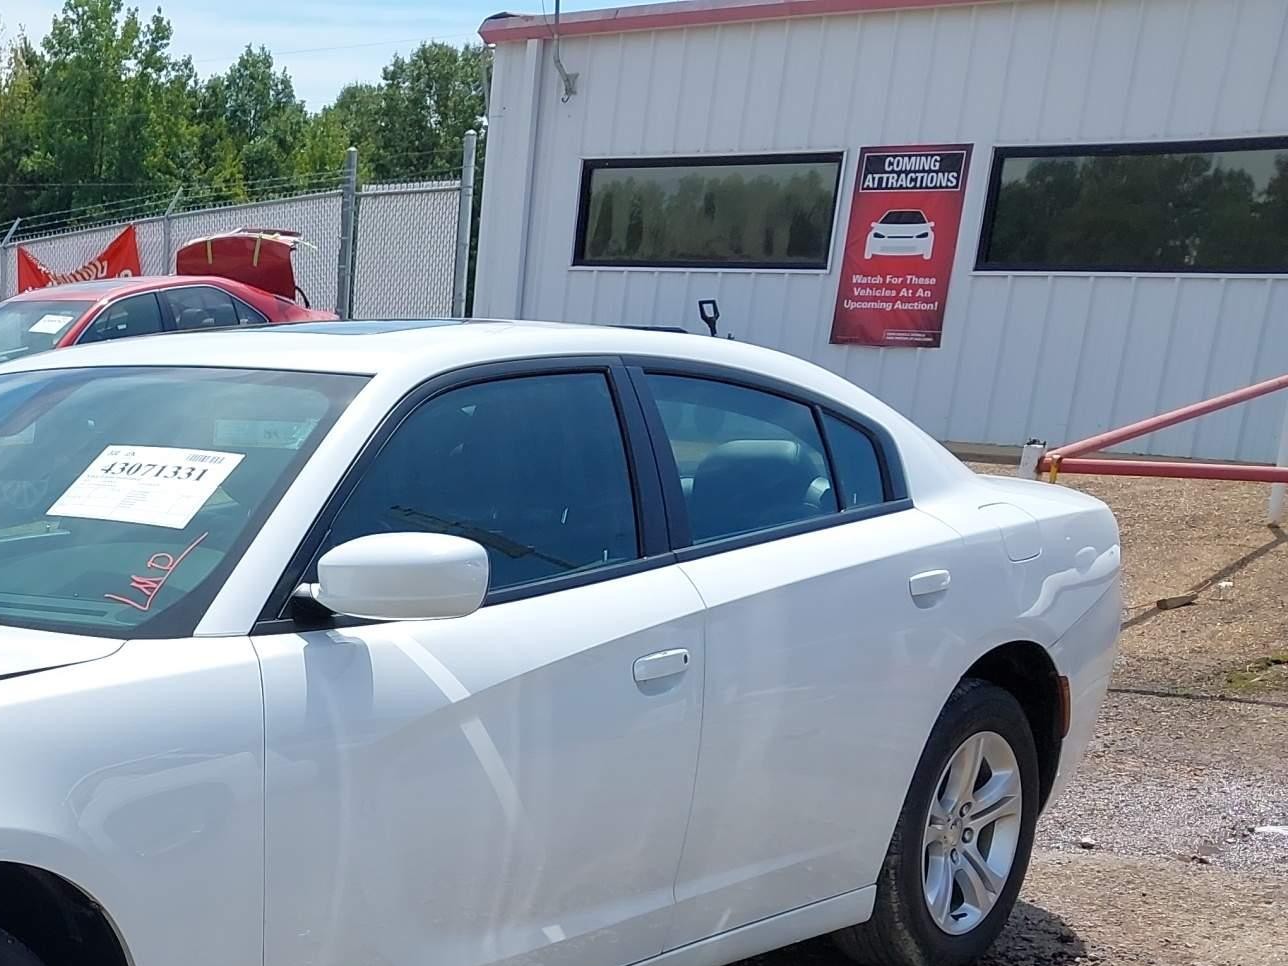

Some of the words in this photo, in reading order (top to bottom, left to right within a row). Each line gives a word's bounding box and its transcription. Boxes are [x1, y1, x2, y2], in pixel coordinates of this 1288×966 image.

[884, 155, 941, 171] COMING
[863, 172, 958, 188] ATTRACTIONS
[852, 274, 883, 284] Watch
[885, 275, 903, 284] For
[906, 275, 937, 285] These
[853, 287, 897, 297] Vehicles
[899, 288, 913, 297] At
[915, 288, 932, 297] An
[843, 299, 892, 311] Upcoming
[893, 300, 939, 311] Auction!
[100, 460, 209, 482] 43071331
